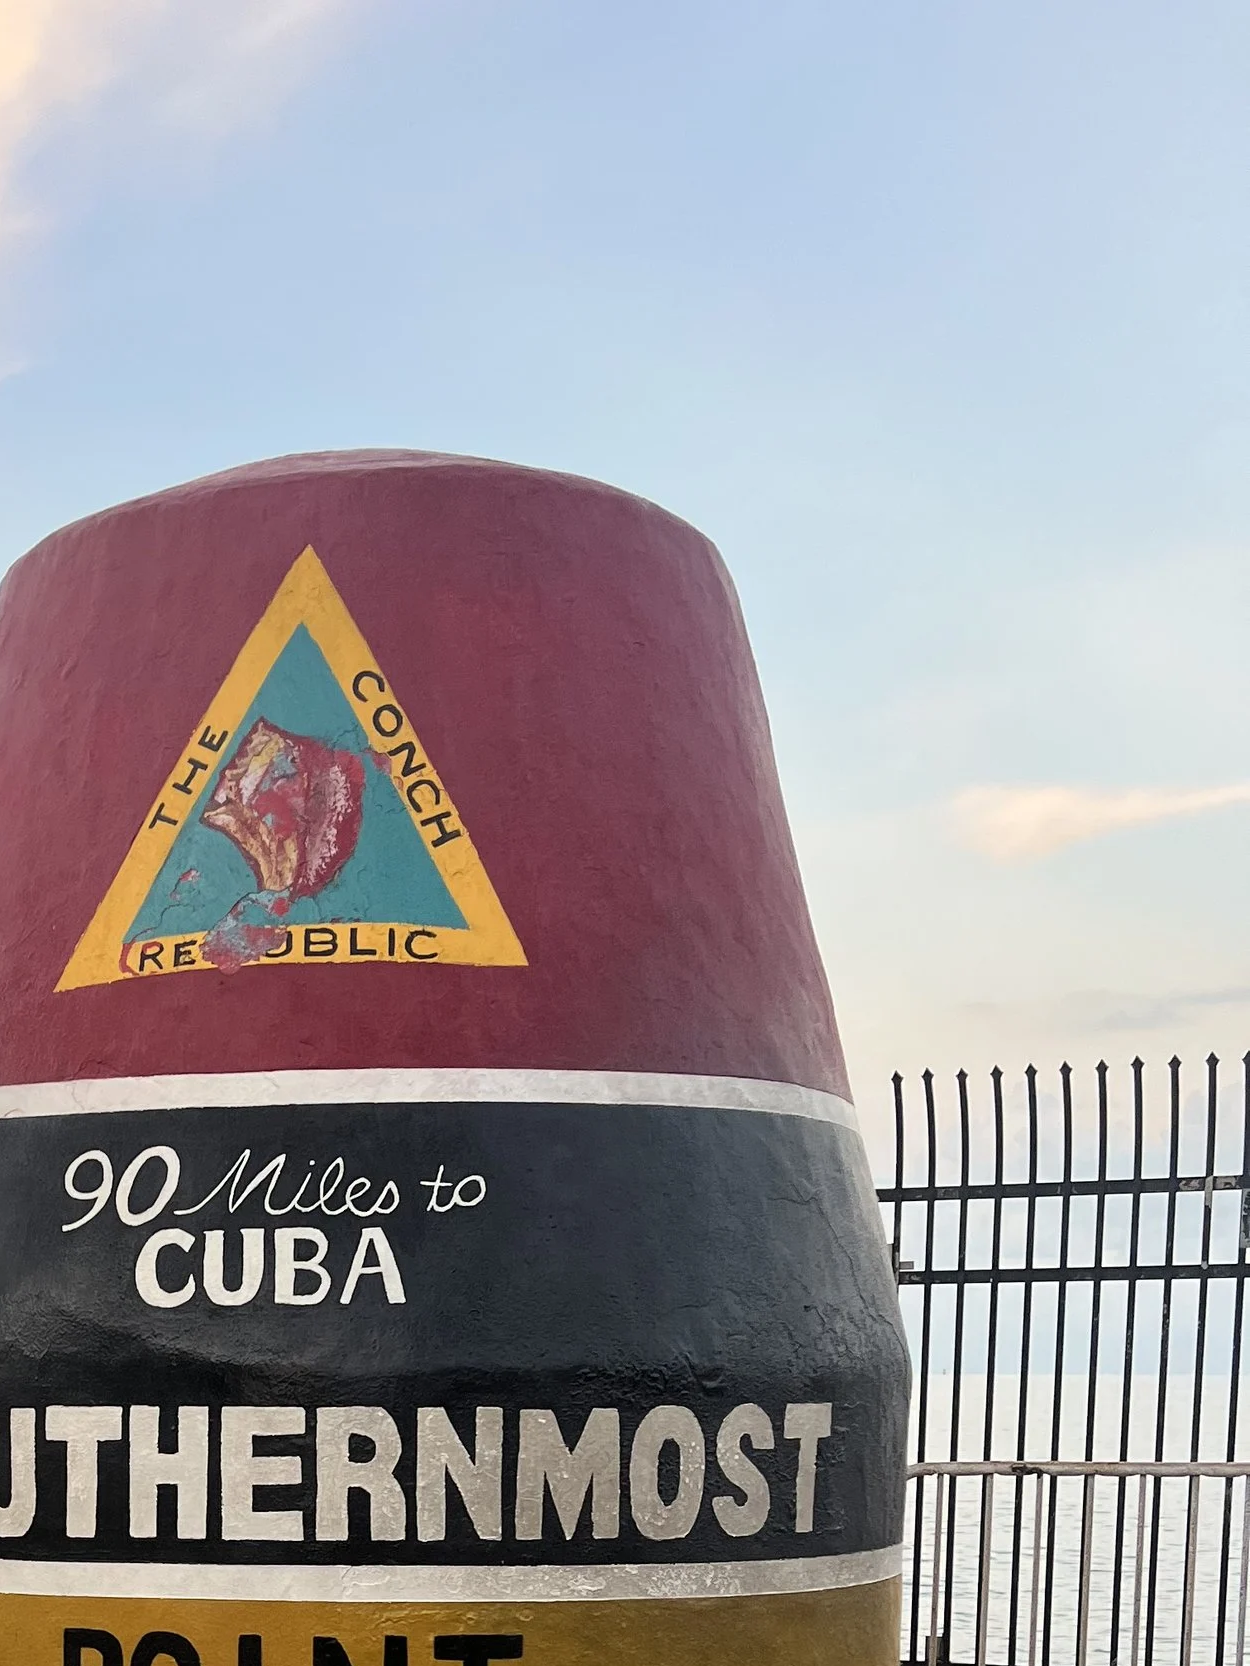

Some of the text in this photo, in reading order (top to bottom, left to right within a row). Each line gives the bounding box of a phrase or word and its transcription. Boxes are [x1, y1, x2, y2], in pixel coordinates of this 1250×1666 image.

[149, 726, 229, 831] THE
[352, 670, 462, 847] CONCH
[138, 927, 440, 973] REUBLIC
[61, 1145, 486, 1232] 90 Miles to
[135, 1226, 406, 1308] CUBA
